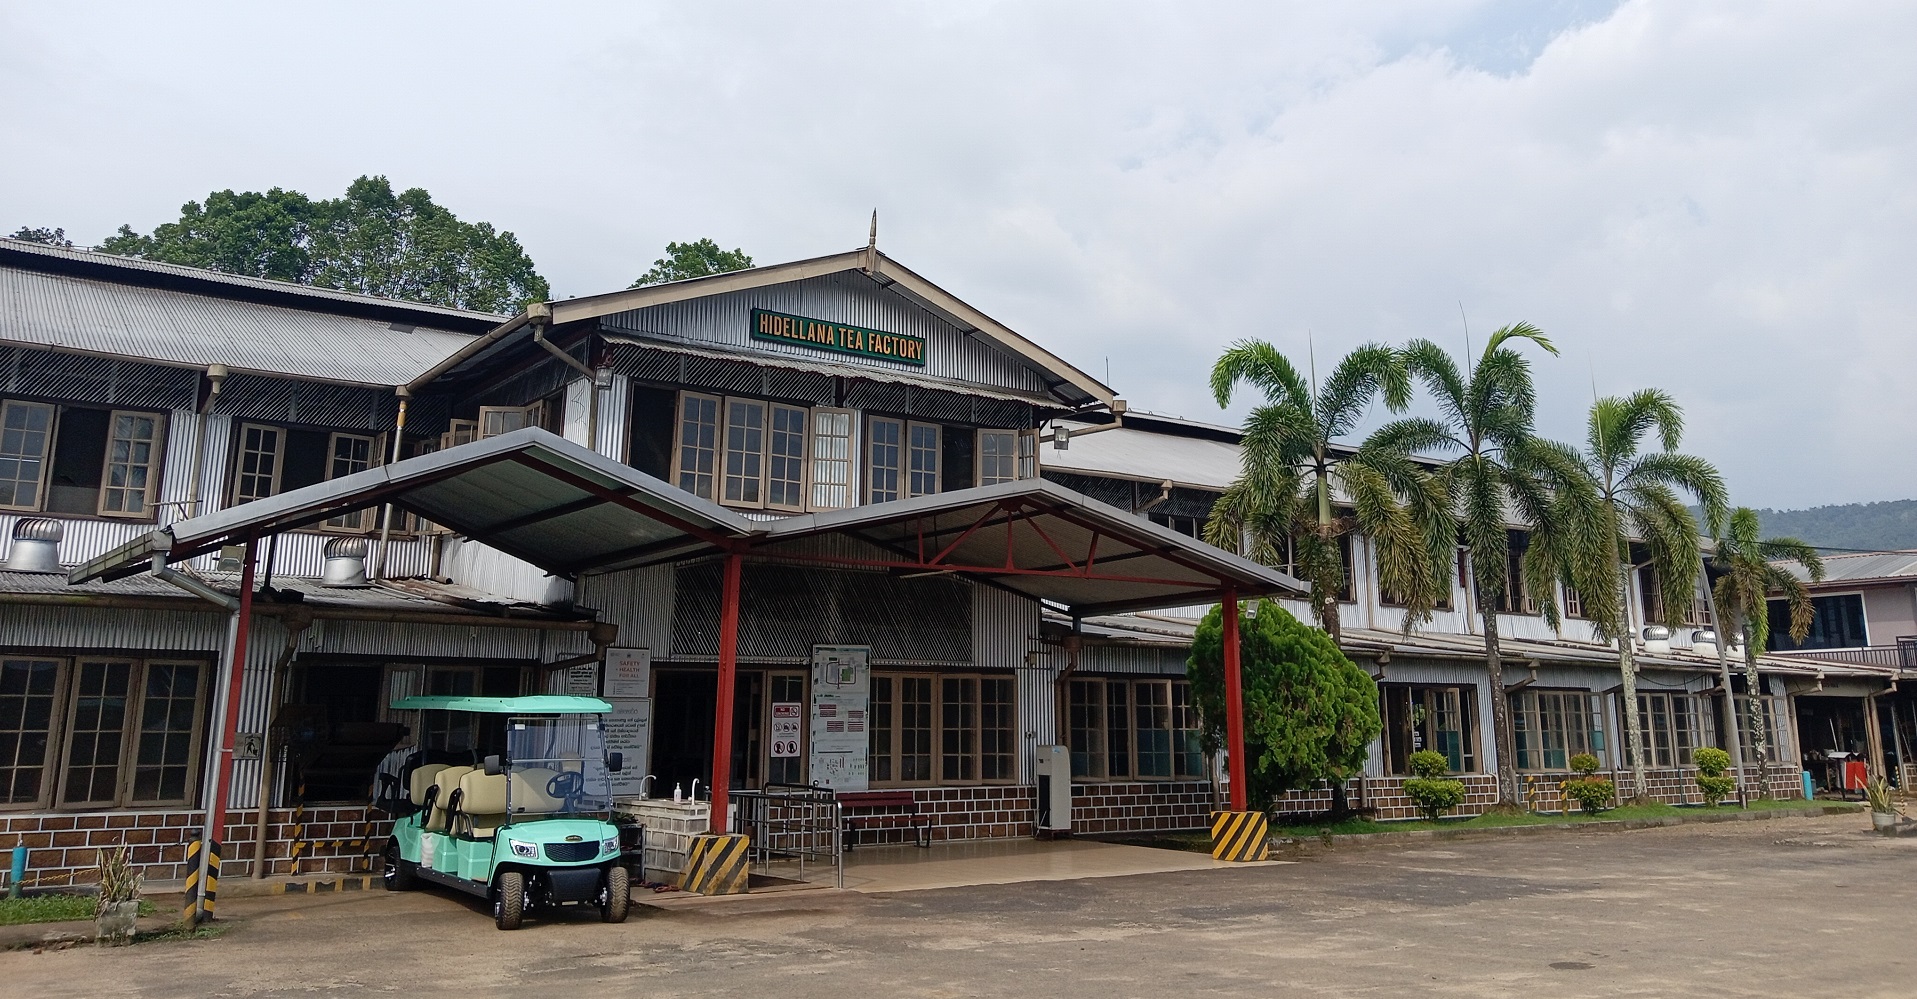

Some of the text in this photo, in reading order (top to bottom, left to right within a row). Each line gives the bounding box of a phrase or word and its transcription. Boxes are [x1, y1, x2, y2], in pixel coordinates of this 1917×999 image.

[760, 313, 923, 360] HIDELLANA TEA FACTORY
